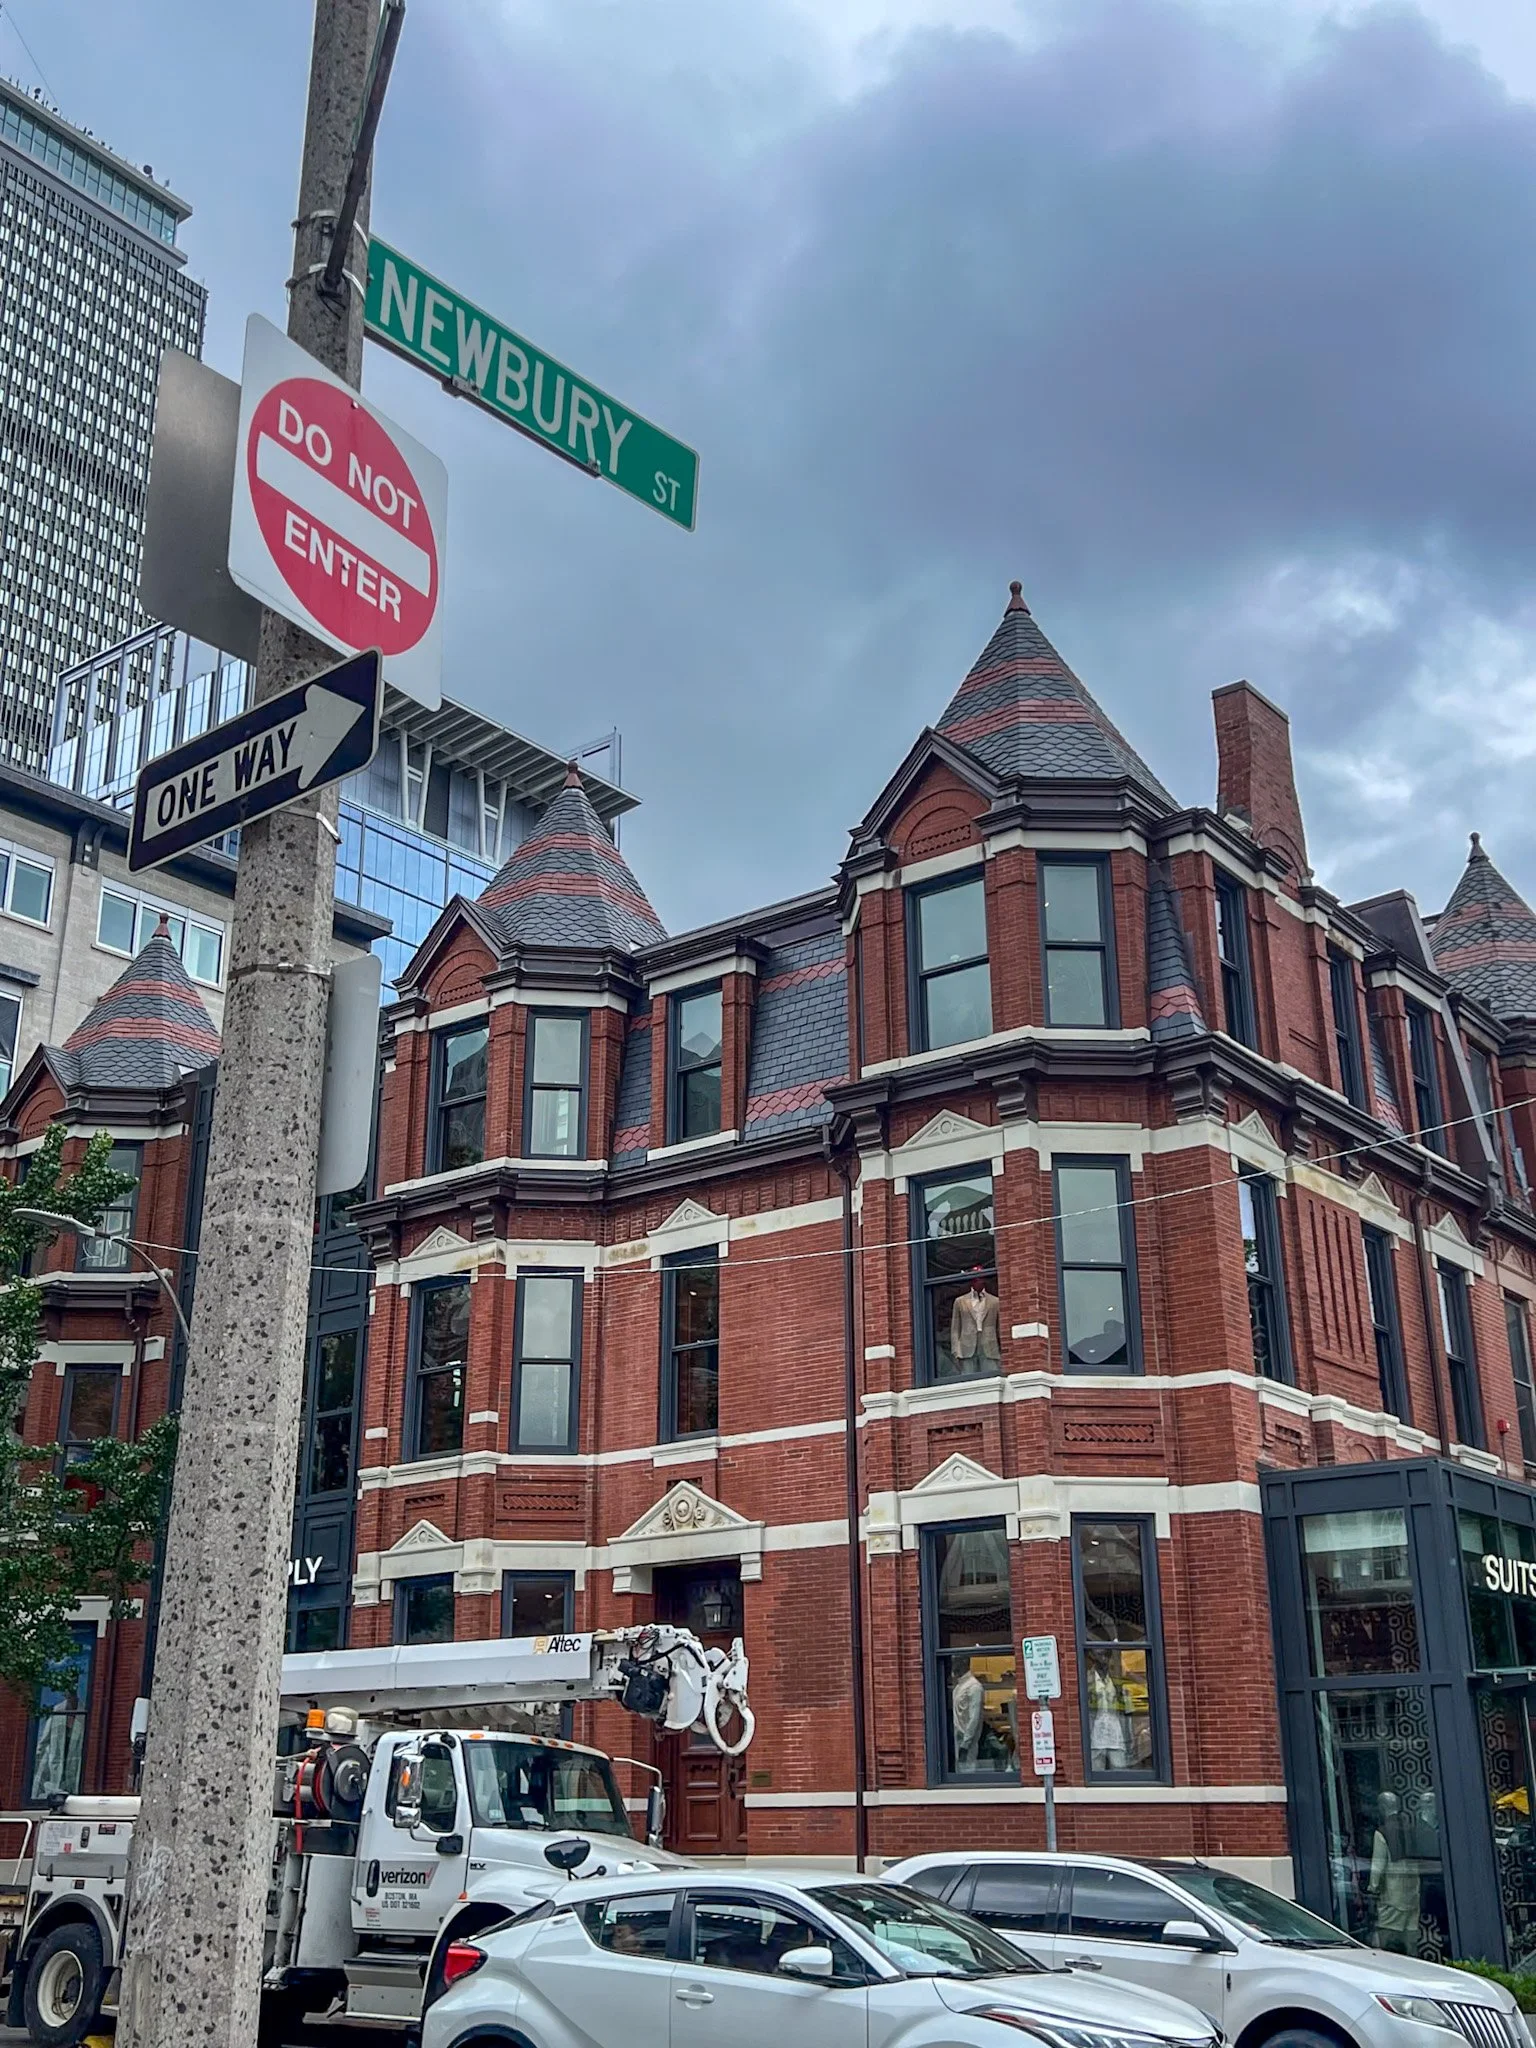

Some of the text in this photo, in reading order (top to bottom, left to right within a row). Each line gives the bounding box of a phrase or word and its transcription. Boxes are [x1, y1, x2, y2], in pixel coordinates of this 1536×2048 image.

[380, 258, 681, 511] NEWBURY ST
[278, 399, 417, 529] DO NOT
[284, 509, 402, 623] ENTER
[157, 721, 297, 827] ONE WAY
[547, 1635, 581, 1653] Altec
[1025, 1641, 1032, 1655] 2
[381, 1867, 426, 1884] verizon
[381, 1900, 389, 1909] US
[390, 1900, 400, 1909] DOT
